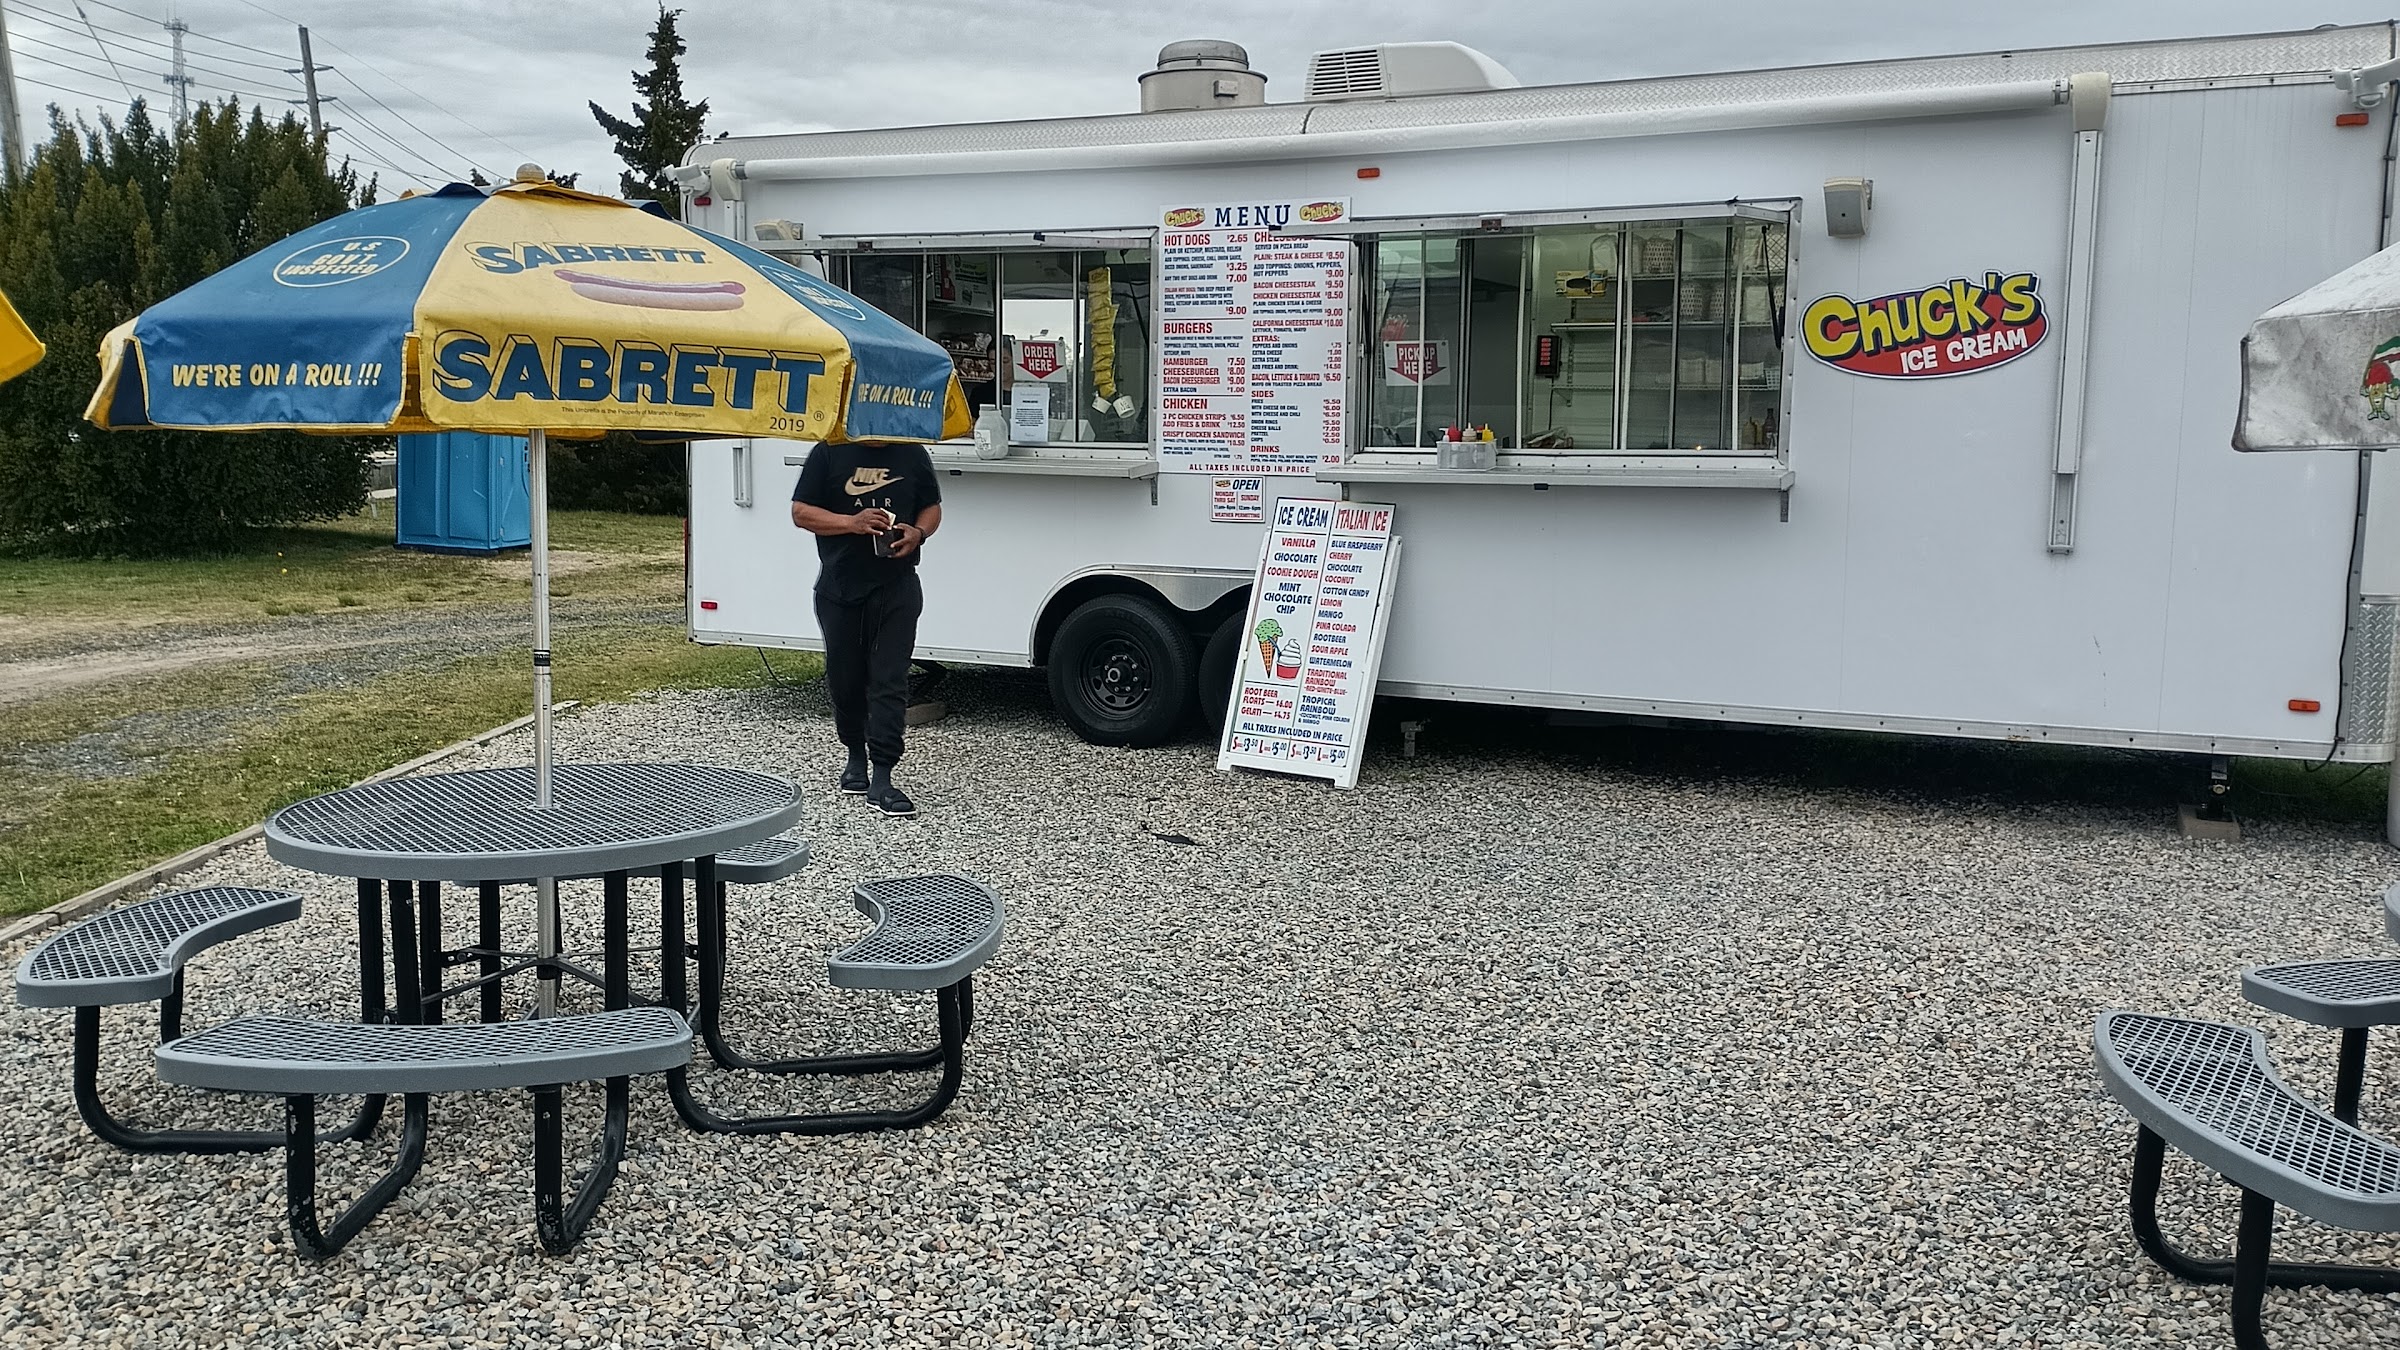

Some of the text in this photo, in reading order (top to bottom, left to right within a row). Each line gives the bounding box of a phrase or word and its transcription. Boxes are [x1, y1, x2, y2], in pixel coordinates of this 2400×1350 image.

[1215, 205, 1291, 227] MENU
[1164, 235, 1182, 246] HOT
[1185, 234, 1210, 245] DOGS
[1227, 234, 1248, 242] $2.65
[464, 242, 707, 274] SABRETT
[1326, 251, 1344, 260] $8.50
[281, 264, 379, 275] INSPECTED
[1227, 262, 1247, 270] $3.25
[1226, 274, 1247, 282] $7.00
[1280, 291, 1321, 299] CHEESESTEAK
[1164, 323, 1213, 333] BURGERS
[1024, 346, 1055, 358] ORDER
[1901, 328, 2028, 374] ICE CREAM
[1029, 359, 1052, 372] HERE
[1228, 367, 1245, 375] $8.00
[1403, 361, 1433, 374] HEE
[172, 364, 241, 388] WE'RE
[250, 363, 280, 386] ON
[286, 363, 298, 385] A
[305, 363, 352, 388] ROLL
[433, 329, 825, 414] SABRETT
[870, 384, 885, 402] ON
[882, 385, 892, 403] A
[891, 386, 916, 406] ROLL
[1163, 398, 1207, 409] CHICKEN
[769, 417, 805, 432] 2019
[1322, 455, 1340, 463] $2.00
[852, 467, 890, 484] NIKE
[1233, 479, 1260, 490] OPEN
[854, 498, 892, 507] AIR
[1278, 506, 1329, 528] ICE CREAM
[1335, 509, 1388, 531] ITALIAN ICE
[1282, 537, 1316, 548] VANILLA
[1331, 540, 1383, 551] BLUE RASPBERRY
[1274, 552, 1318, 564] CHOCOLATE
[1329, 552, 1353, 560] CHERRY
[1267, 566, 1318, 579] COOKIE DOUGH
[1327, 563, 1363, 573] CHOCOLATE
[1325, 575, 1354, 584] COCONUT
[1279, 582, 1302, 592] MINT
[1322, 587, 1369, 598] COTTON CANDY
[1264, 592, 1312, 604] CHOCOLATE
[1320, 598, 1342, 607] LEMON
[1276, 604, 1295, 614] CHIP
[1318, 610, 1343, 619] MANGO
[1331, 623, 1356, 632] COLADA
[1313, 633, 1347, 643] ROOTBEER
[1311, 645, 1349, 656] SOUR APPLE
[1309, 657, 1352, 668] WATERMELON
[1307, 668, 1347, 680] TRADITIONAL
[1305, 677, 1337, 687] RAINBOW
[1245, 687, 1278, 698] ROOT BEER
[1243, 696, 1265, 705] FLOATS
[1302, 695, 1336, 706] TROPICAL
[1241, 706, 1262, 716] GELATI
[1300, 704, 1336, 715] RAINBOW
[1242, 722, 1343, 742] ALL TAXES INCLUDED IN PRICE
